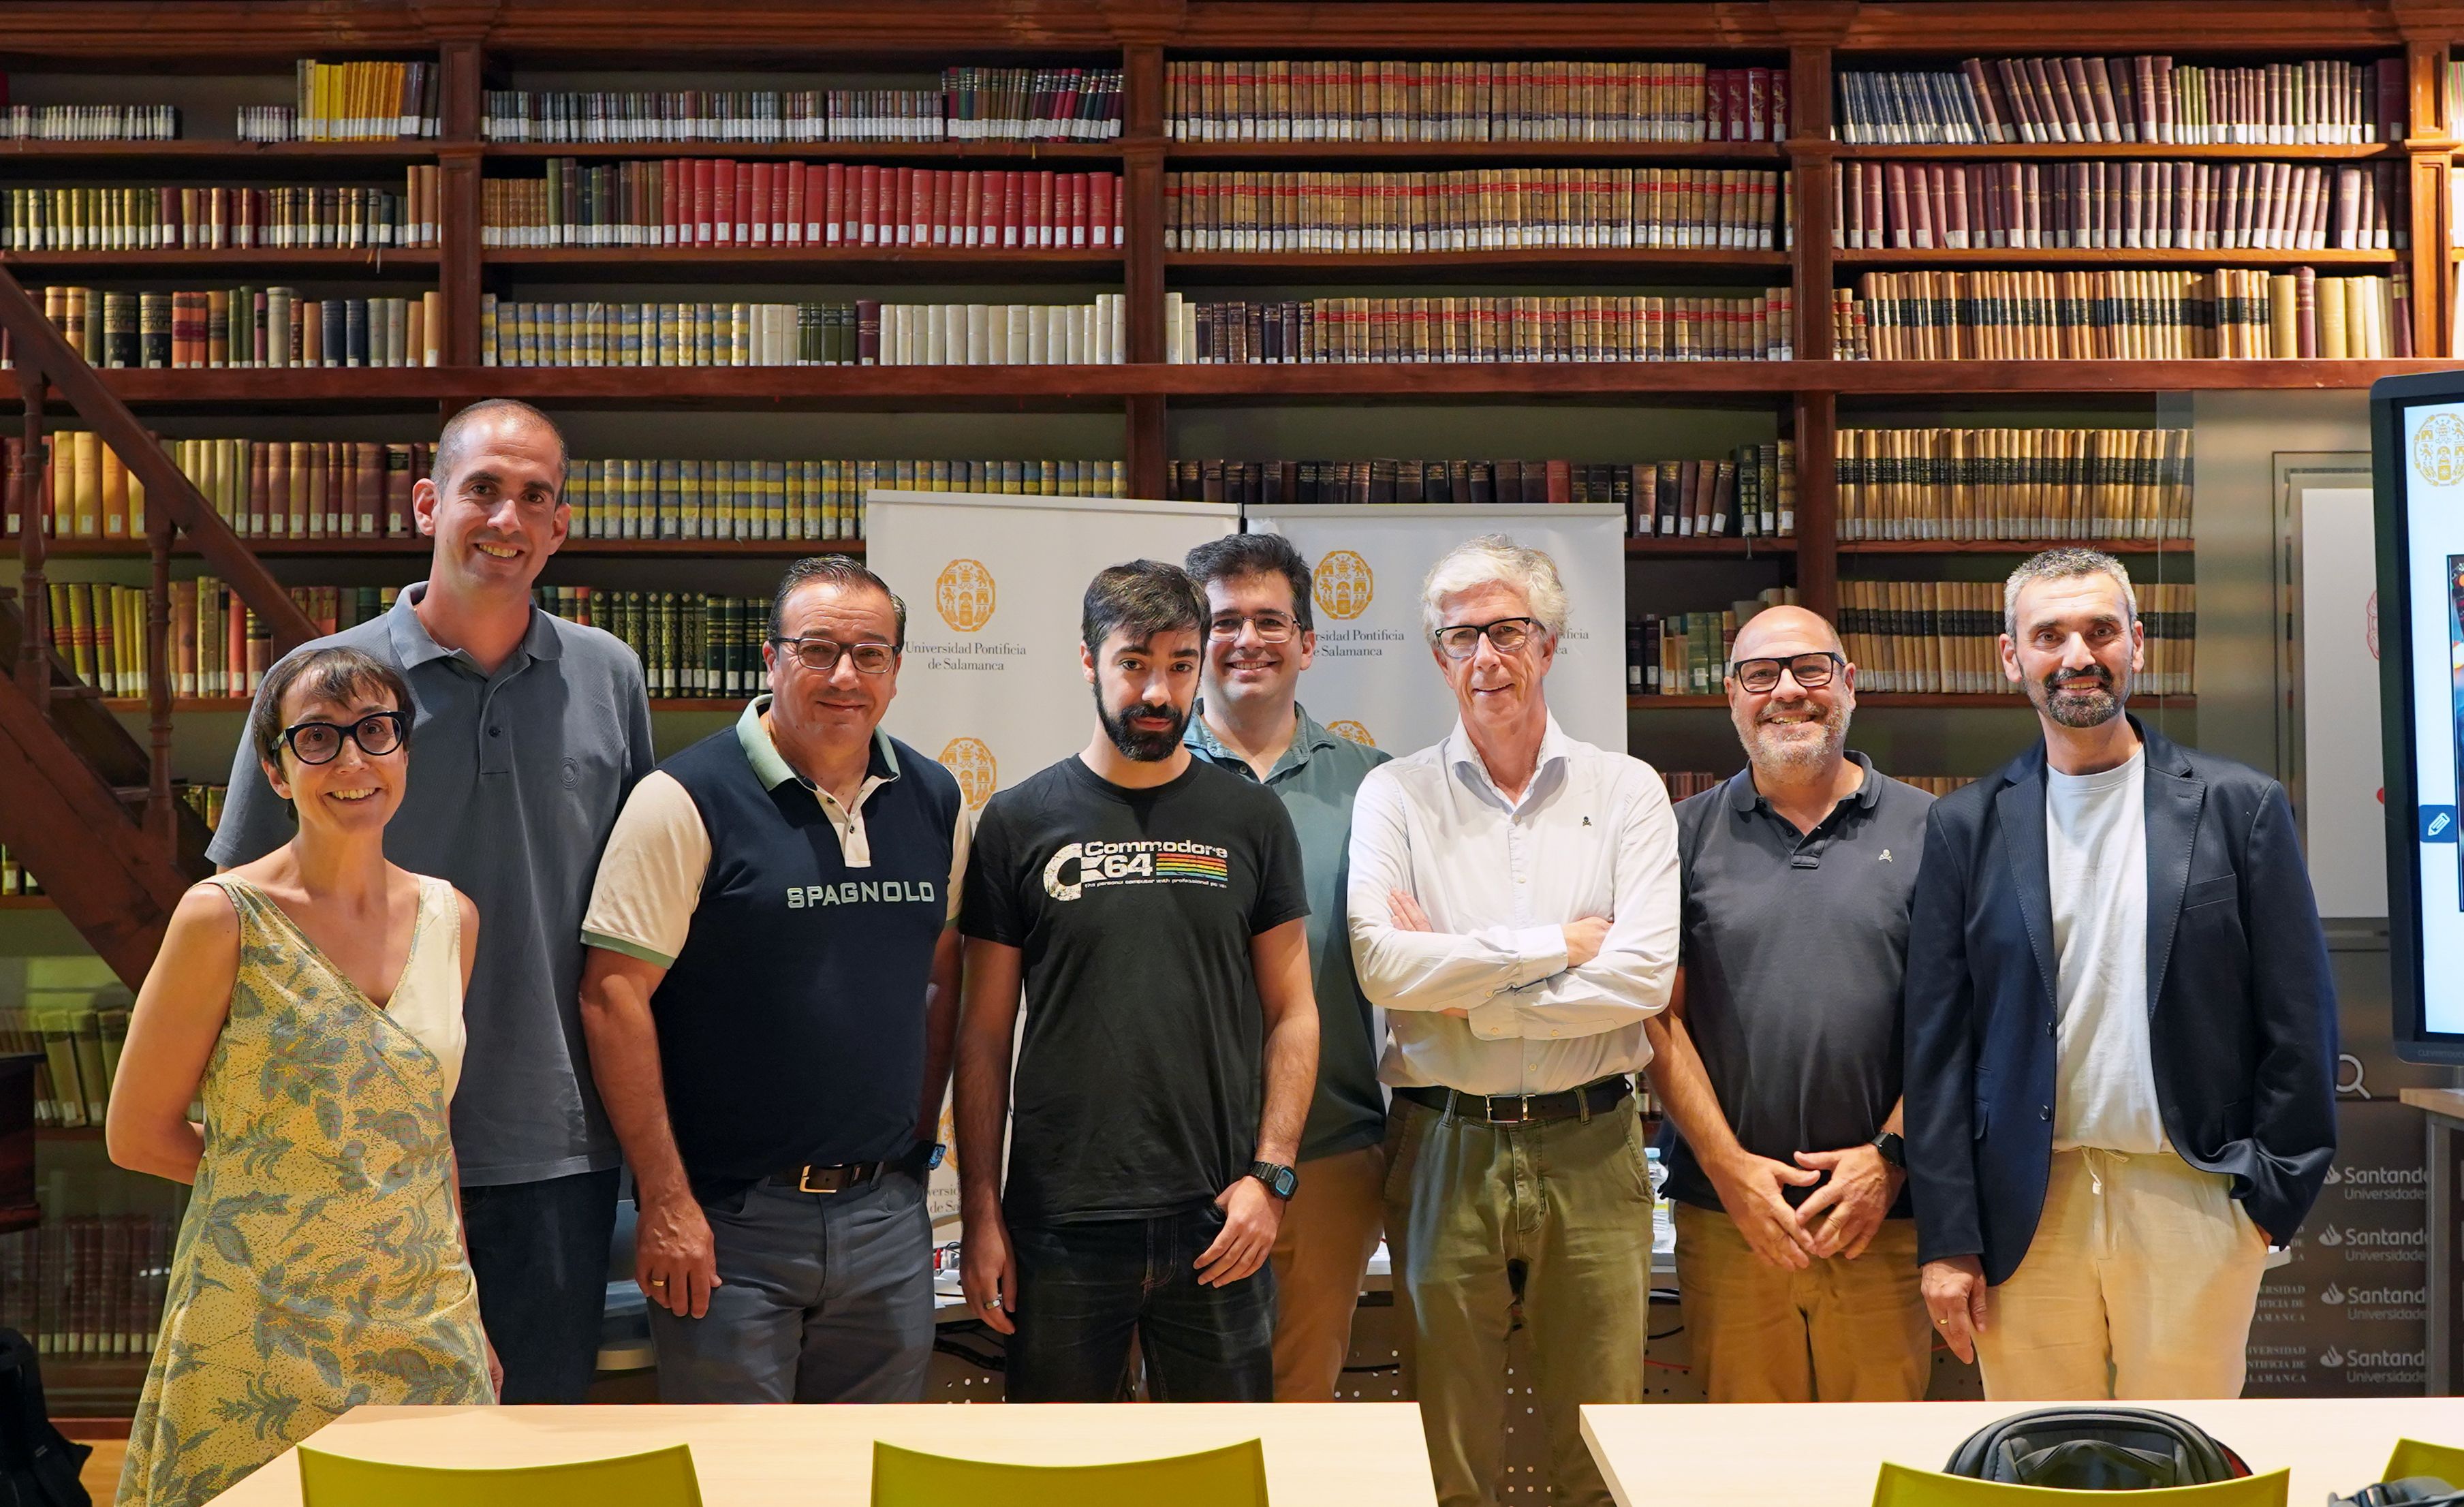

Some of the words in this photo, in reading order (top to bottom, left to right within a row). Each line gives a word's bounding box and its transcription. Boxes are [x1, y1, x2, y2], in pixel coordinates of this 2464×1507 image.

[1353, 630, 1405, 641] Pontificia
[905, 641, 972, 654] Universidad
[975, 642, 1027, 655] Pontificia
[1322, 645, 1383, 657] Salamanca
[928, 658, 941, 670] de
[944, 657, 1004, 670] Salamanca
[1085, 839, 1228, 858] Commodore
[1104, 853, 1153, 879] 64
[786, 881, 935, 909] SPAGNOLO
[929, 1201, 943, 1213] de
